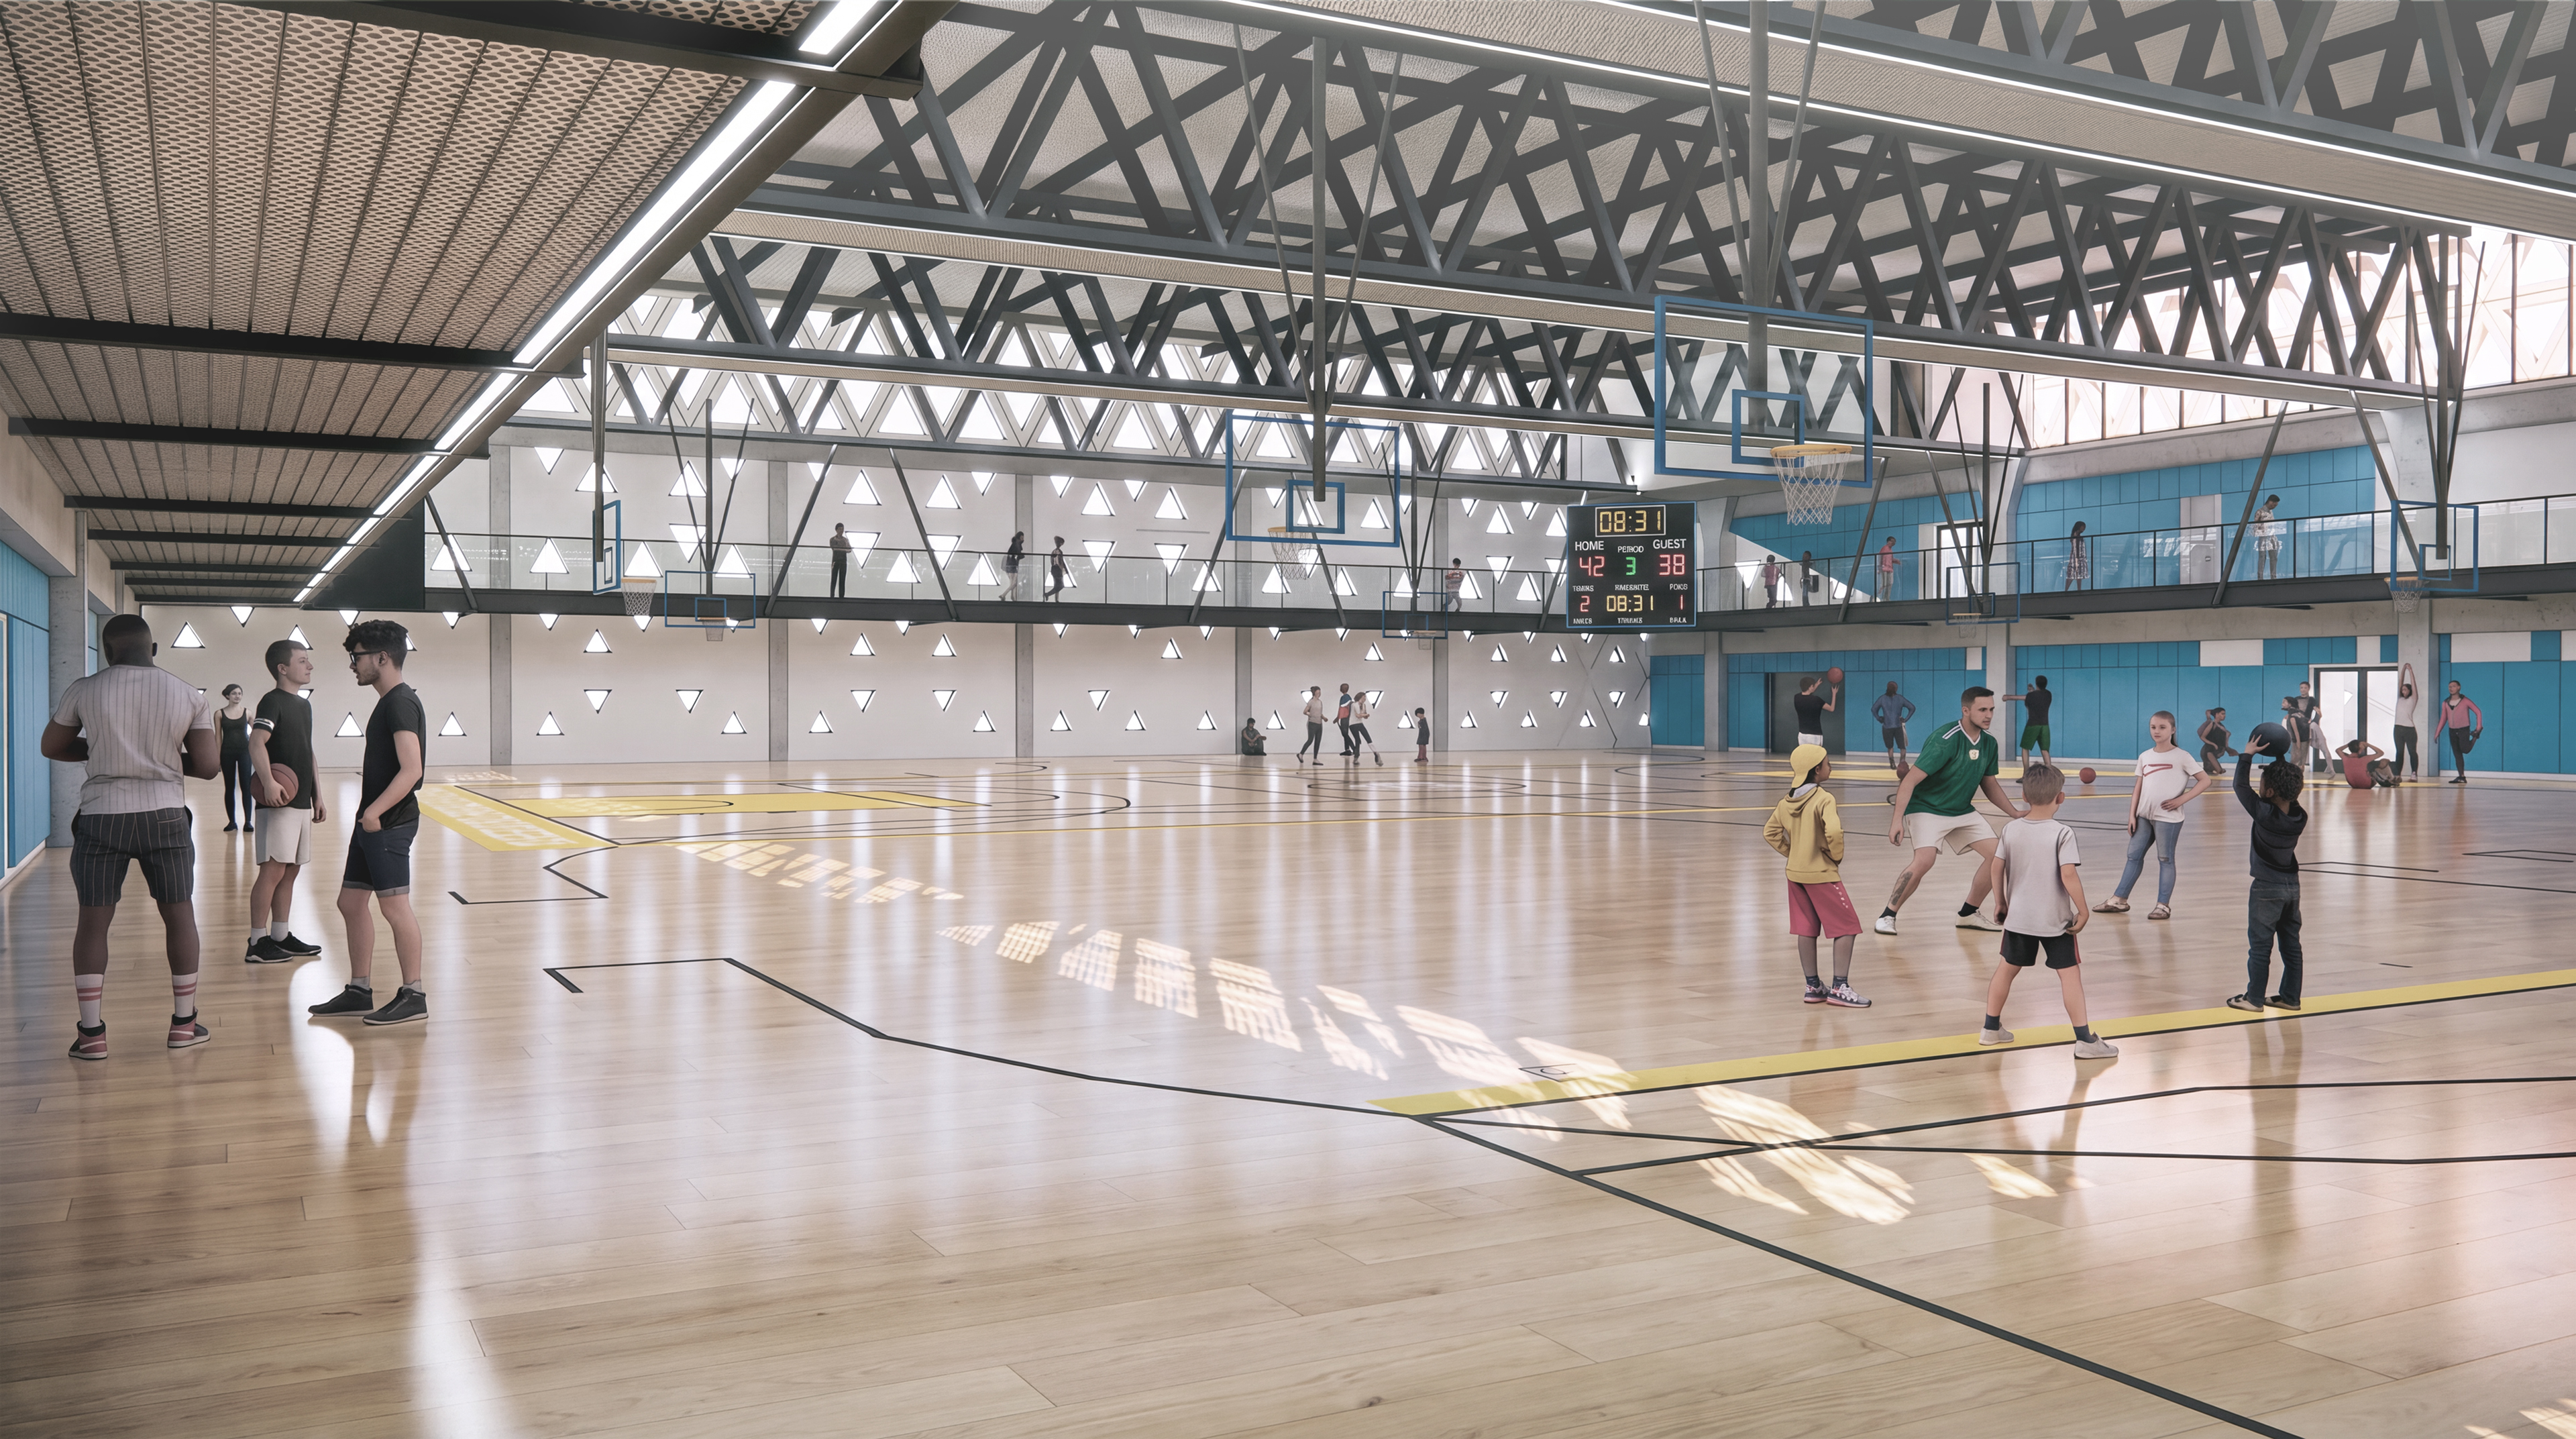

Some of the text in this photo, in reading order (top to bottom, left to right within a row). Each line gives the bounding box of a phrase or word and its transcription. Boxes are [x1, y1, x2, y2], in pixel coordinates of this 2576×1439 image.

[1600, 511, 1661, 533] 08:31
[1575, 541, 1604, 551] HOME
[1653, 539, 1686, 549] GUEST
[1579, 556, 1605, 577] 42
[1625, 557, 1636, 576] 3
[1659, 554, 1685, 576] 38
[1580, 596, 1590, 612] 2
[1607, 595, 1654, 612] 08:31
